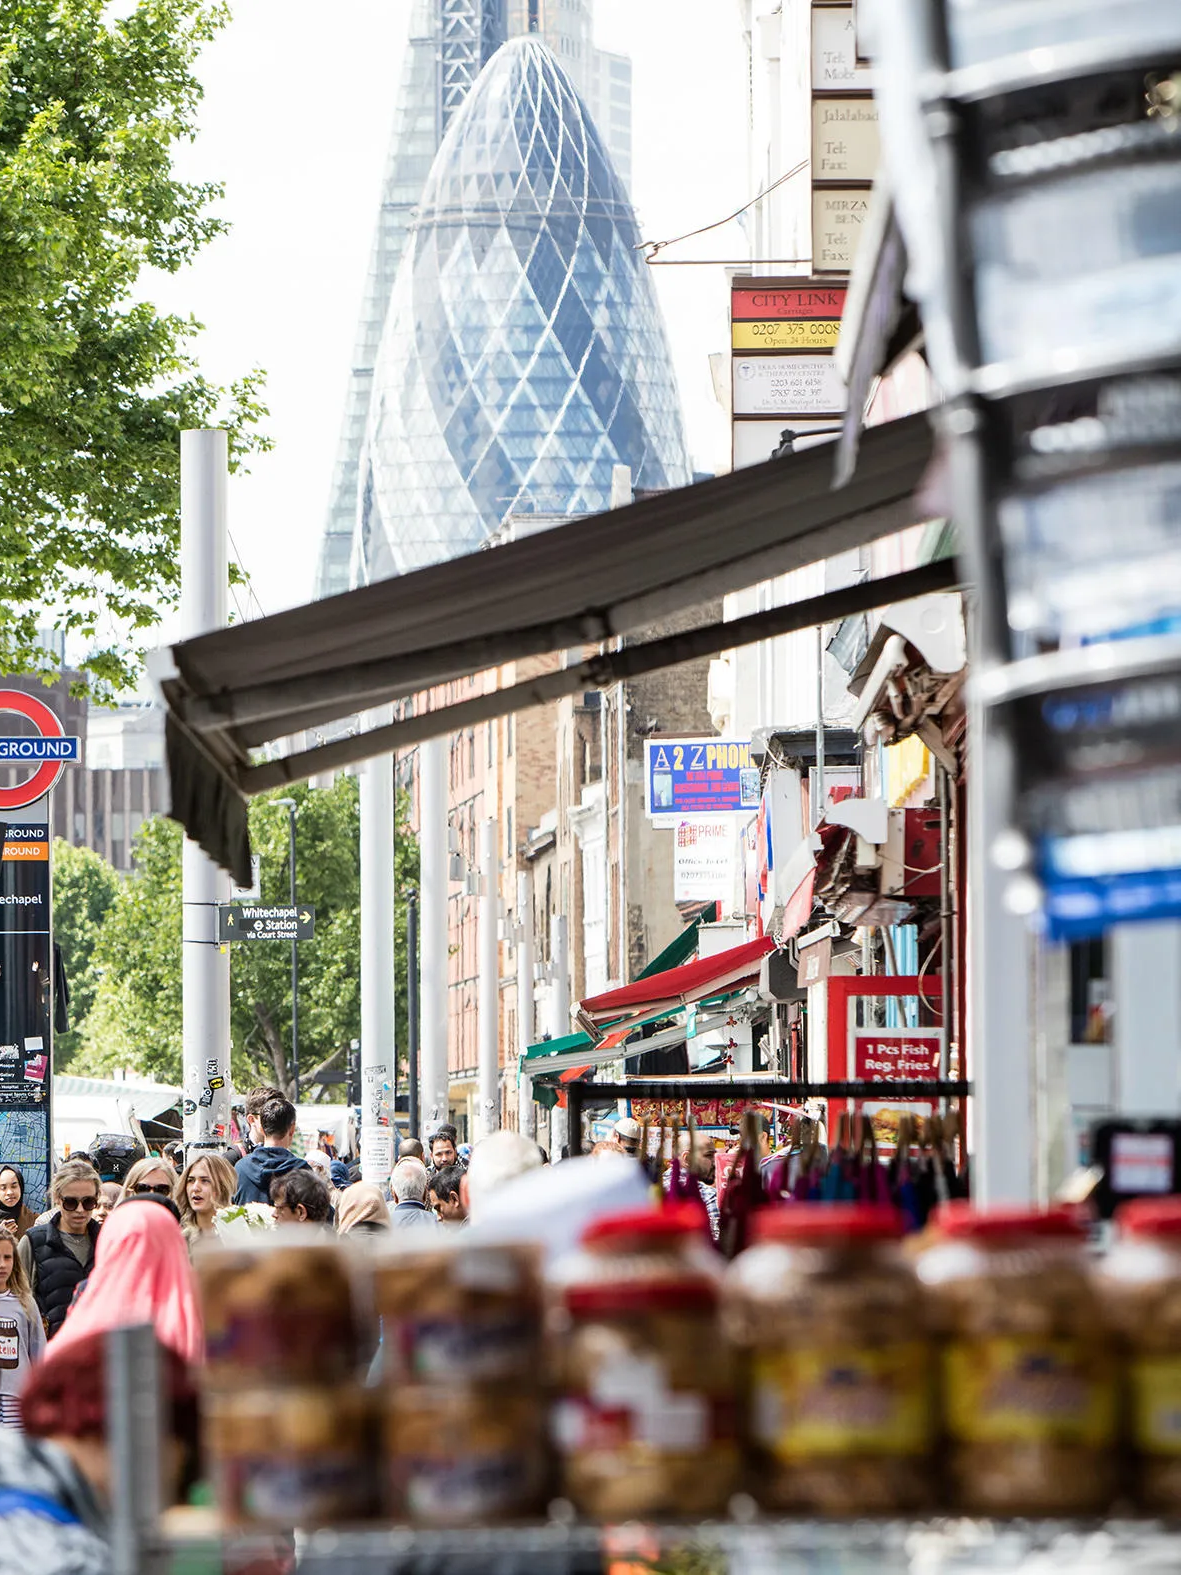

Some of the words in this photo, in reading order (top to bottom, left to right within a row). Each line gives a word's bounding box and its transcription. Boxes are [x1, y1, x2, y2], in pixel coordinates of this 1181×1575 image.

[825, 142, 847, 154] Tel:
[821, 158, 847, 170] Fax:
[825, 200, 867, 210] MIRZA
[825, 233, 847, 244] Tel:
[822, 249, 849, 260] Fax:
[752, 294, 789, 306] CITY
[797, 293, 838, 306] LINK
[752, 324, 779, 335] 0207
[787, 324, 805, 334] 375
[764, 337, 787, 346] Open
[654, 747, 671, 769] A
[673, 746, 684, 770] 2
[690, 746, 704, 768] Z
[242, 907, 297, 919] Whitechapel
[266, 920, 297, 930] Station
[867, 1045, 874, 1054] 1
[877, 1044, 899, 1055] Pcs
[901, 1044, 929, 1055] Fish
[865, 1060, 895, 1072] Reg.
[898, 1060, 930, 1070] Fries
